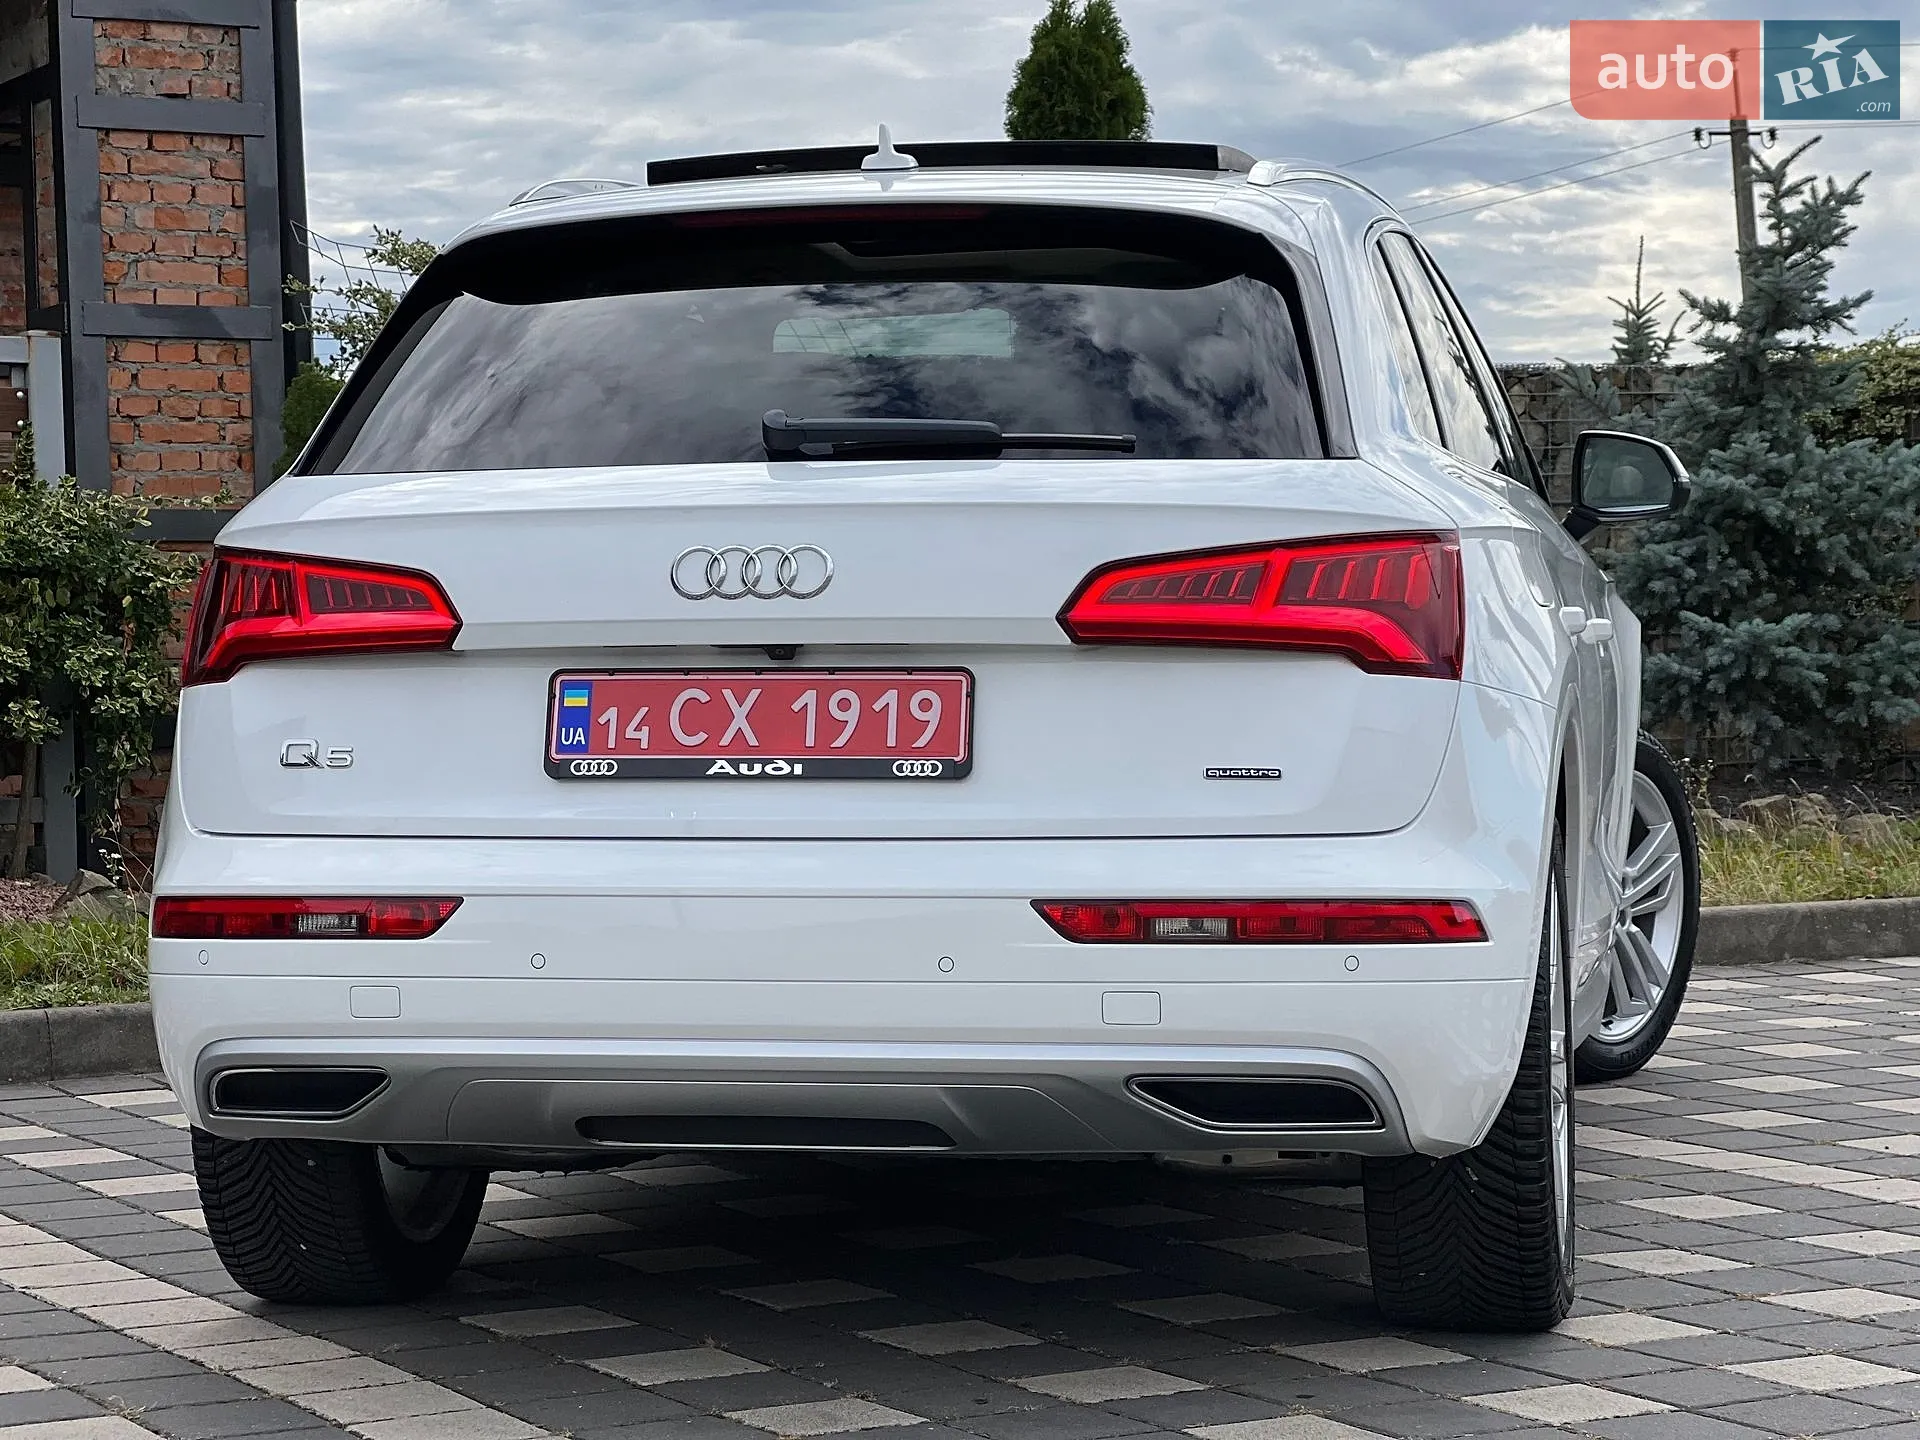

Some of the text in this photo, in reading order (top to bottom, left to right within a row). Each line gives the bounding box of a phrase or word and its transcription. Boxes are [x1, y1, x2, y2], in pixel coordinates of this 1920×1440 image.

[597, 688, 942, 749] 14 CX 1919
[561, 727, 586, 745] UA
[280, 738, 354, 769] Q5
[705, 759, 803, 776] Audi
[1207, 769, 1280, 777] quattro
